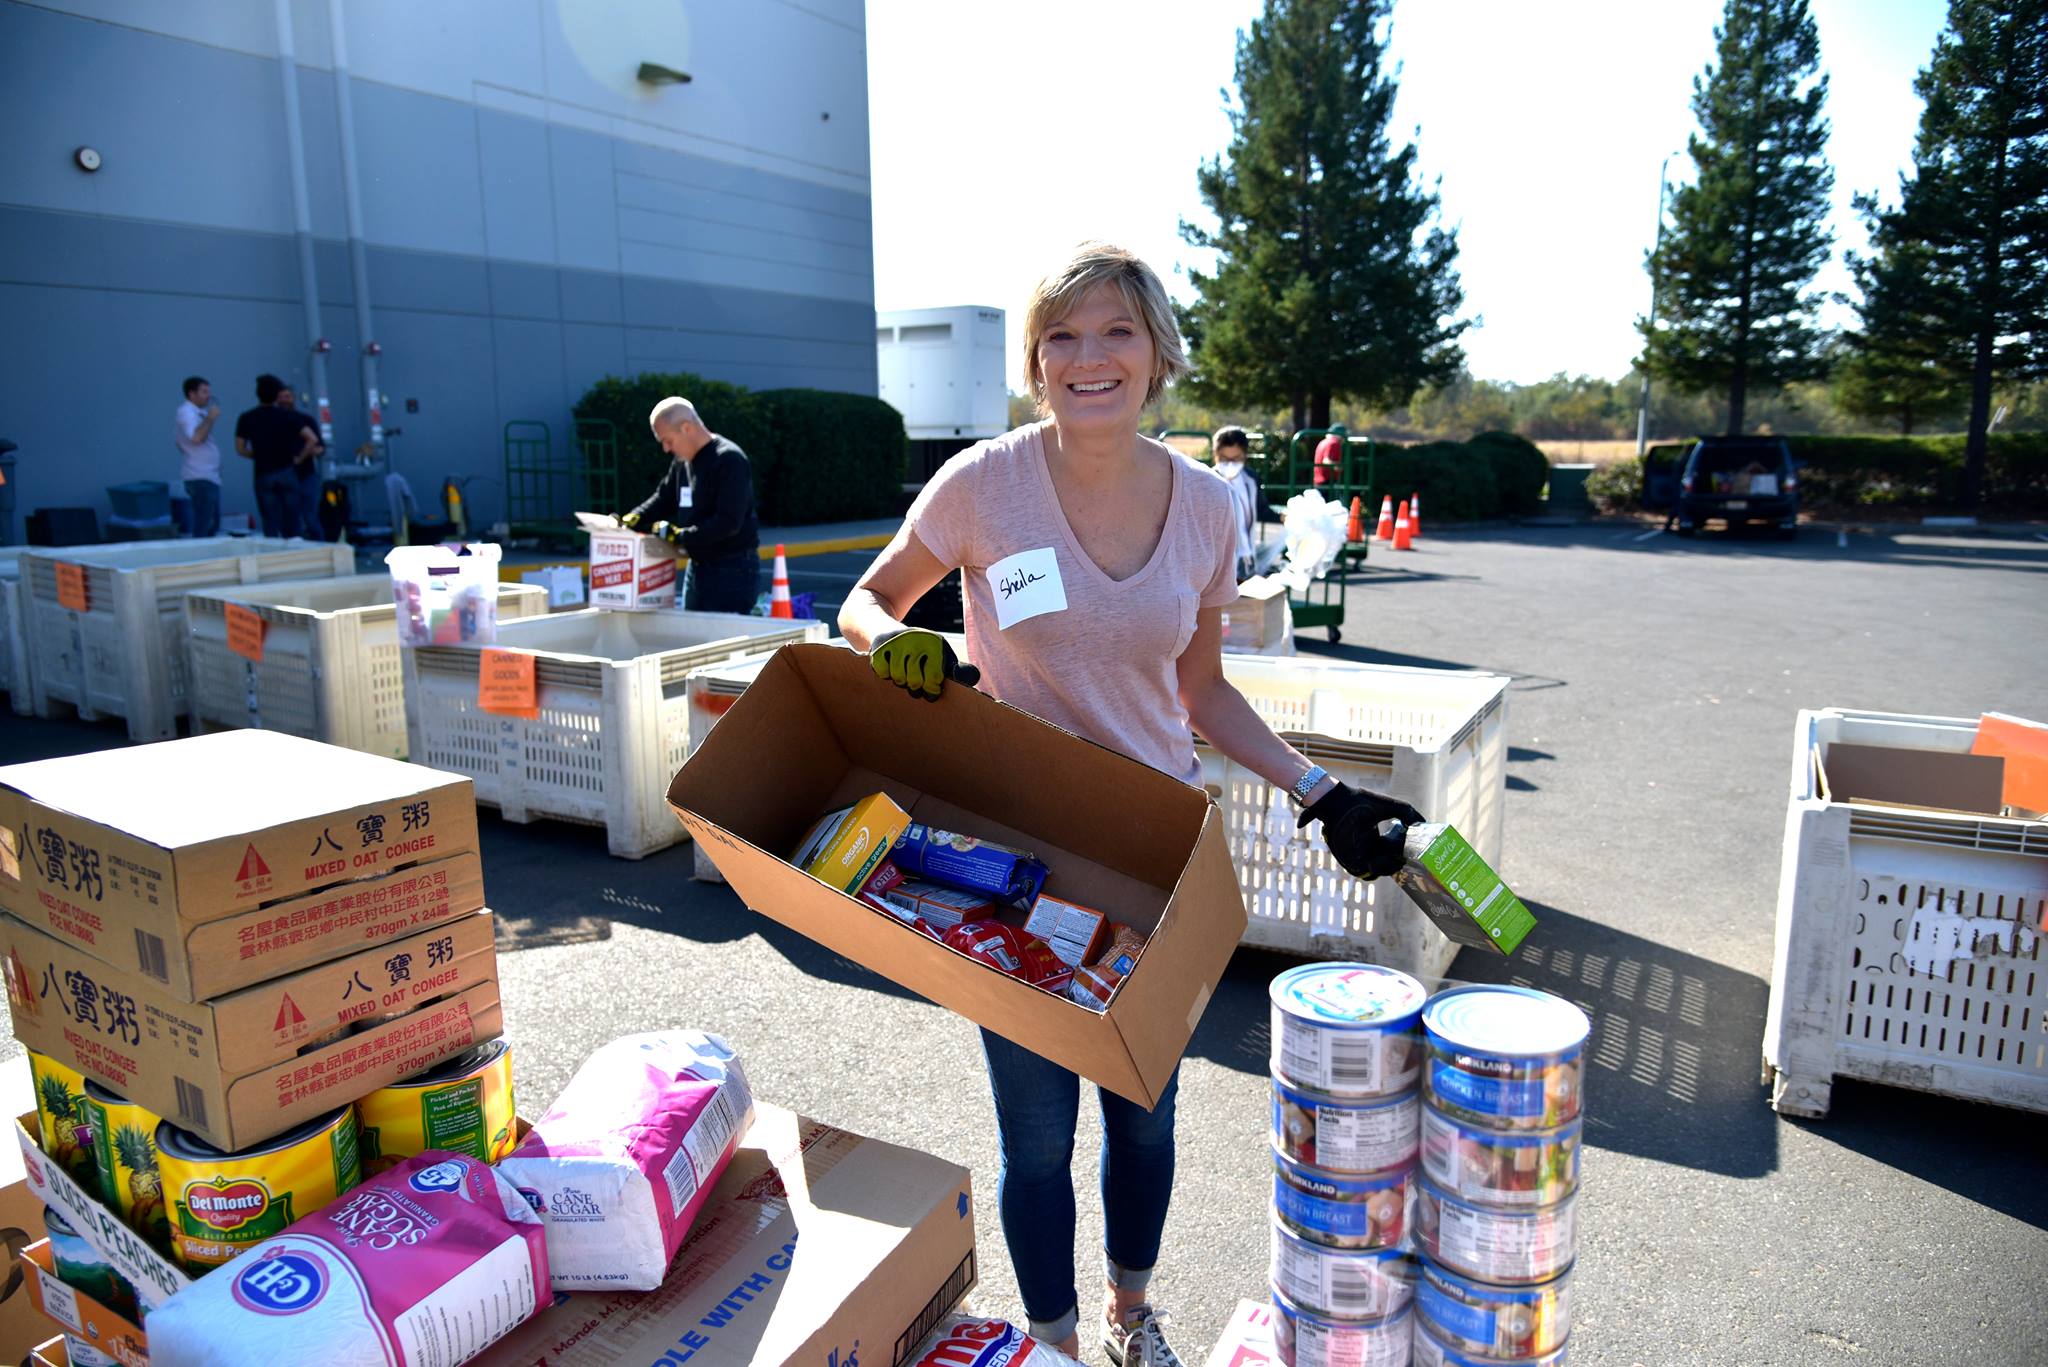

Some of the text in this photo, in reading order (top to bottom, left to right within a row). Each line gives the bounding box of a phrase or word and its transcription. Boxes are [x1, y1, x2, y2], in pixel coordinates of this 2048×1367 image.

[1000, 568, 1046, 600] Sheila
[305, 835, 436, 881] MIXED OAT CONGEE
[841, 833, 866, 865] ORGANIC
[856, 861, 872, 881] active
[366, 916, 408, 939] 370gm
[410, 913, 419, 925] X
[338, 968, 459, 1024] MIXED OAT CONGEE
[396, 1051, 436, 1075] 370gm
[437, 1043, 446, 1056] X
[189, 1193, 263, 1211] Del Monte
[551, 1204, 602, 1215] SUGAR
[552, 1193, 594, 1205] CANE
[329, 1203, 398, 1251] CANE
[348, 1192, 427, 1246] SUGAR
[185, 1240, 219, 1257] Sliced
[700, 1272, 773, 1329] WITH
[552, 1318, 600, 1356] Monde
